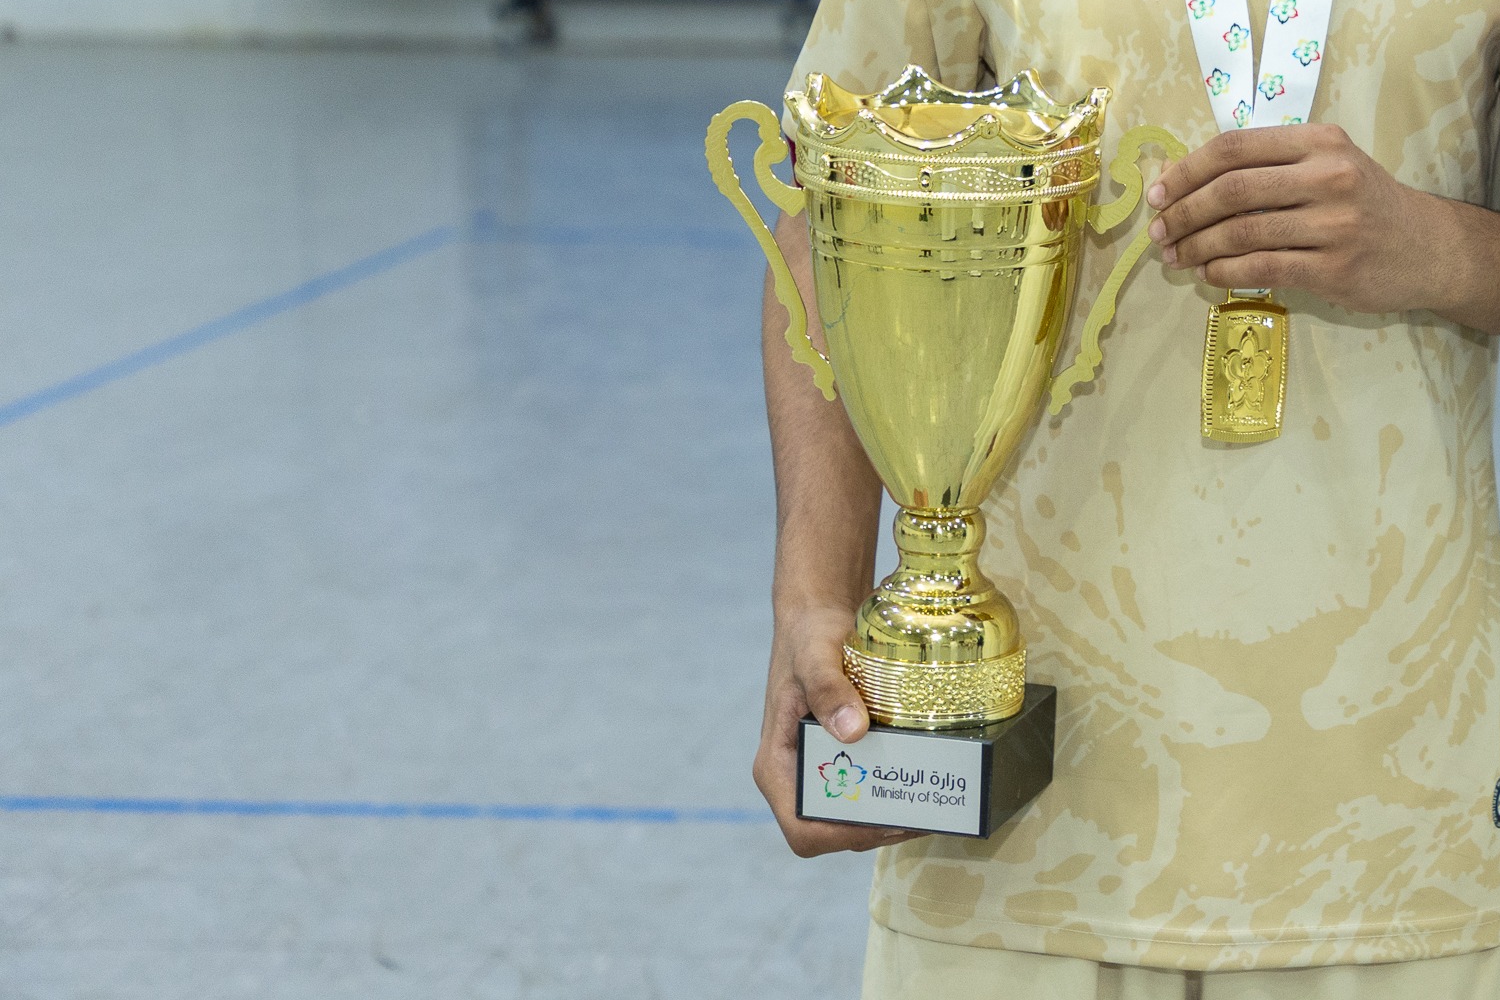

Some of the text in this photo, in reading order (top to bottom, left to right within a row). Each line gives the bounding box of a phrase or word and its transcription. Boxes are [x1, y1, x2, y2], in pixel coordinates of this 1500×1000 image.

[872, 765, 966, 792] وزارة الرياضة
[871, 785, 966, 807] Ministry of Sport
